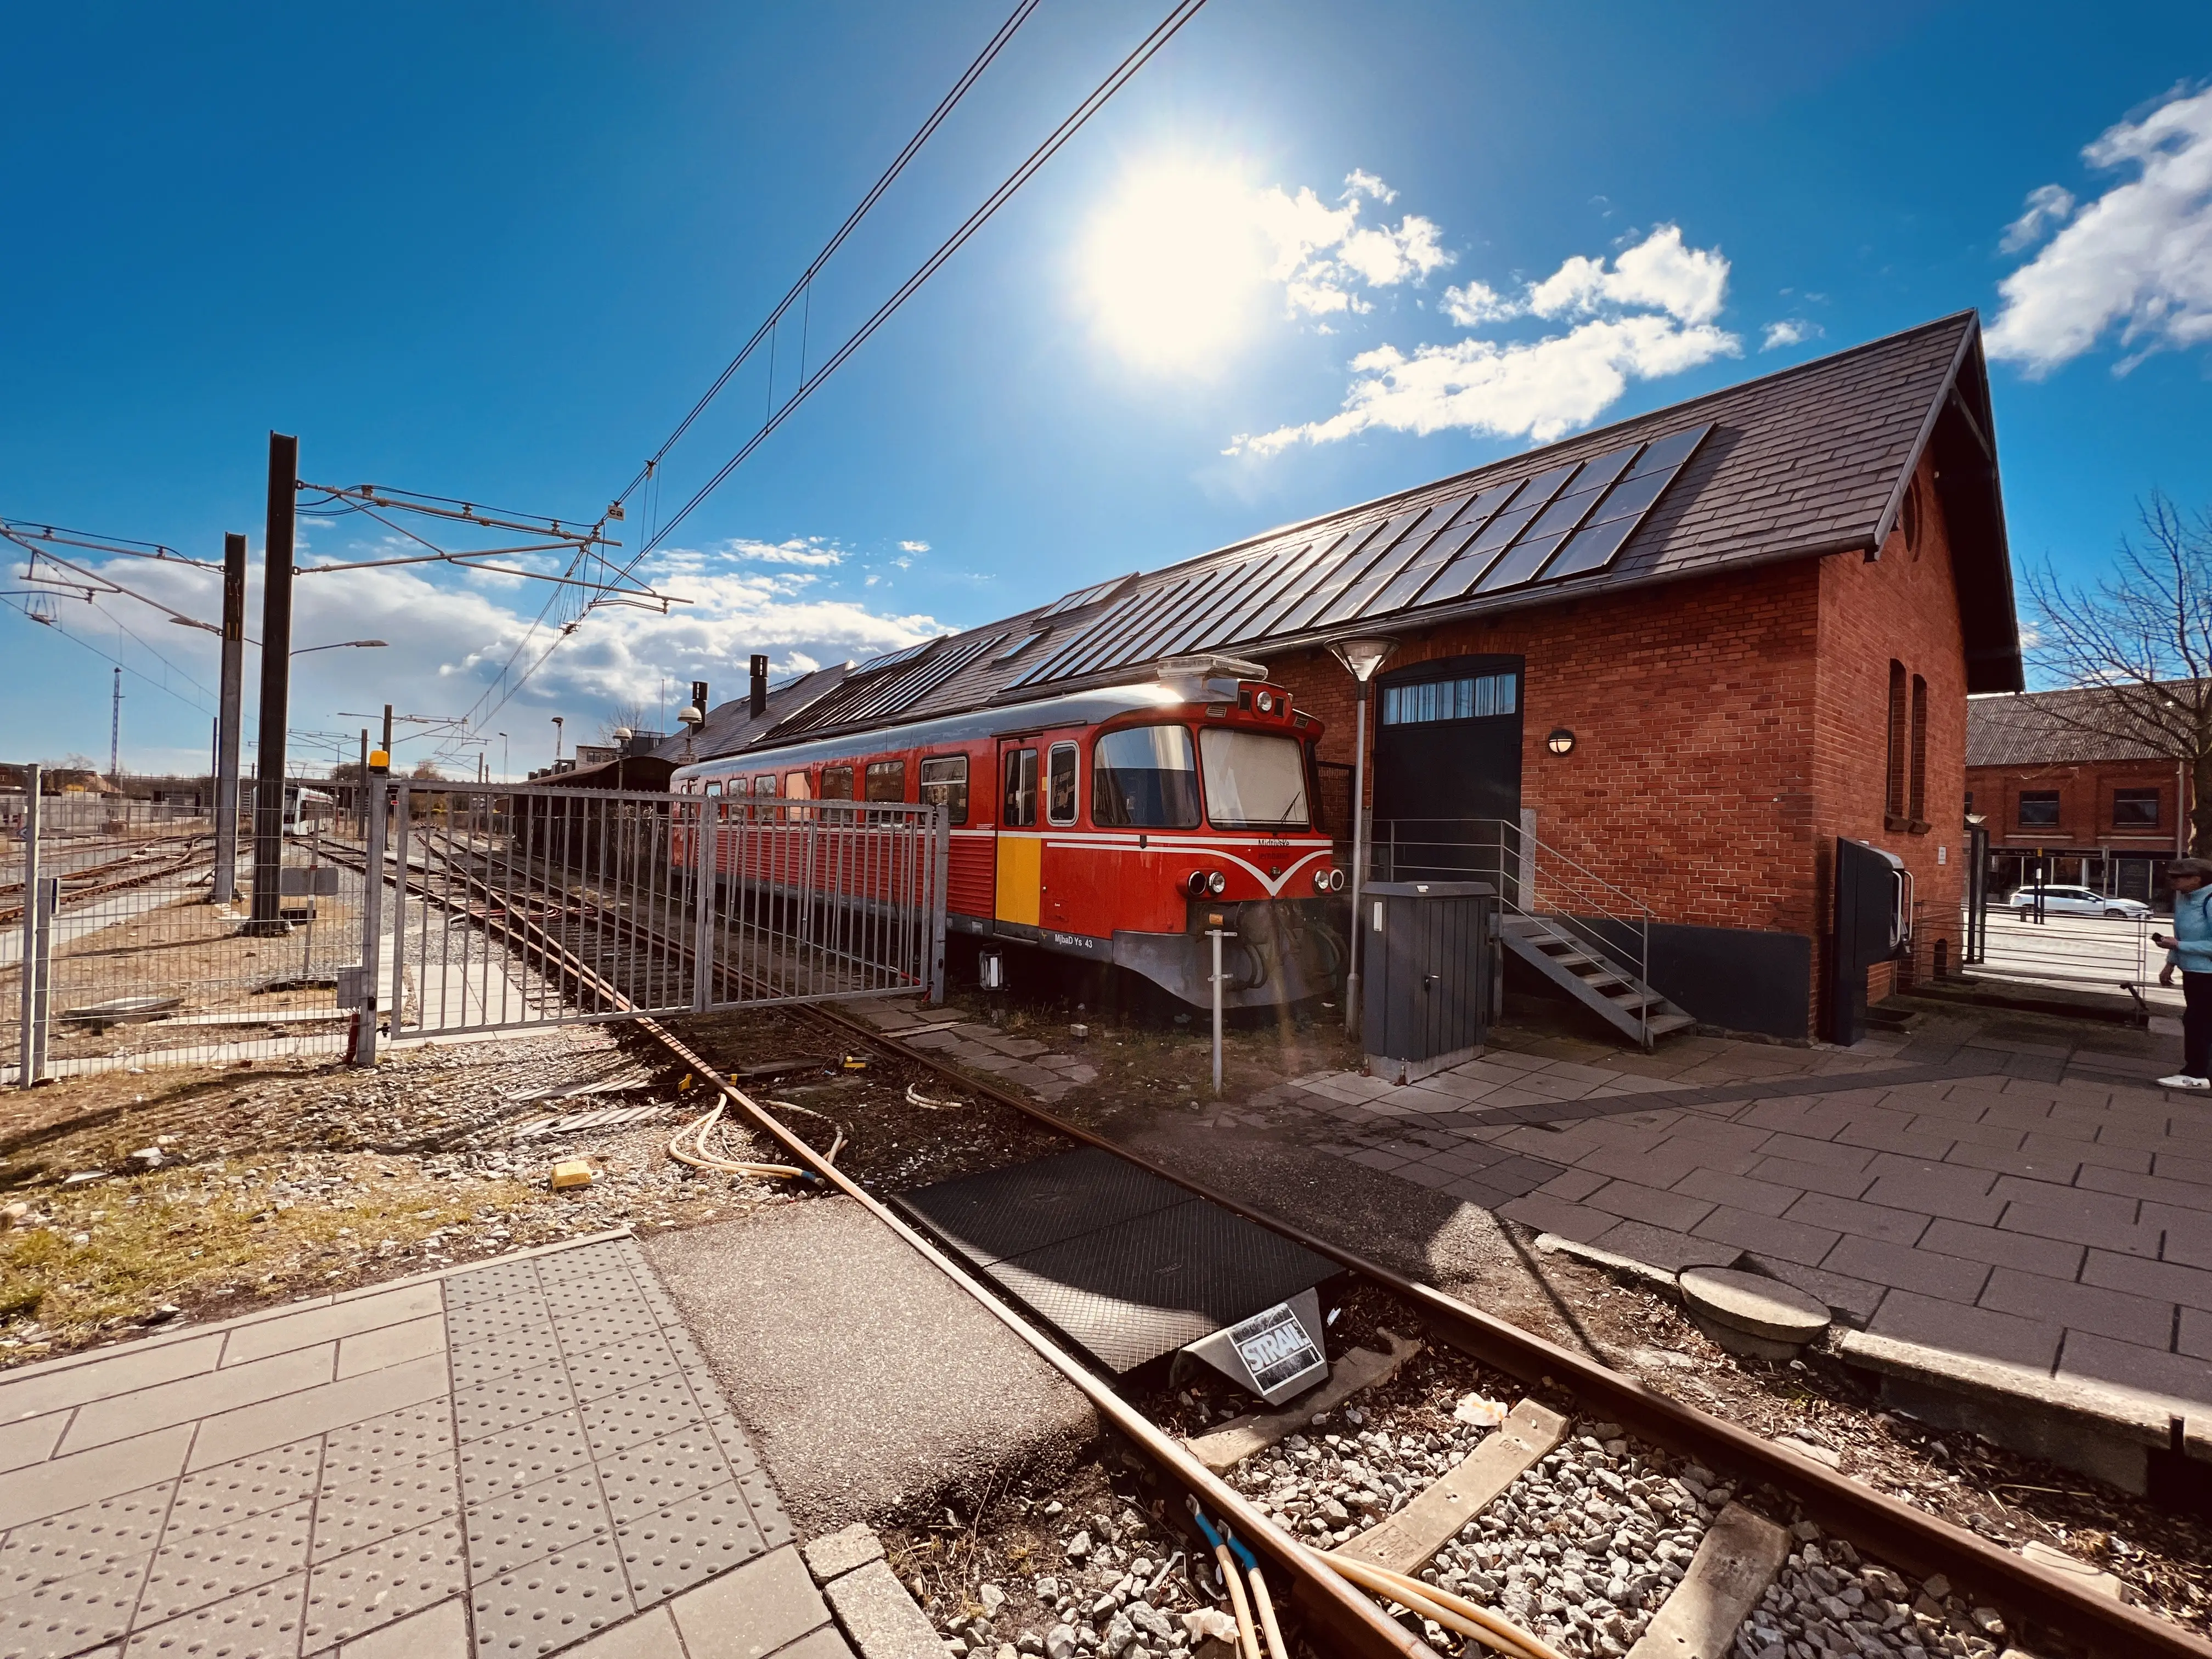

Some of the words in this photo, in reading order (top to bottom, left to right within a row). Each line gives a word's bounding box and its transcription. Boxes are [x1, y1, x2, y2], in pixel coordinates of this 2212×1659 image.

[1055, 934, 1073, 945] MjbaD
[1074, 937, 1082, 946] Ys
[1085, 939, 1093, 949] 43
[1242, 1322, 1312, 1371] STRAIL
